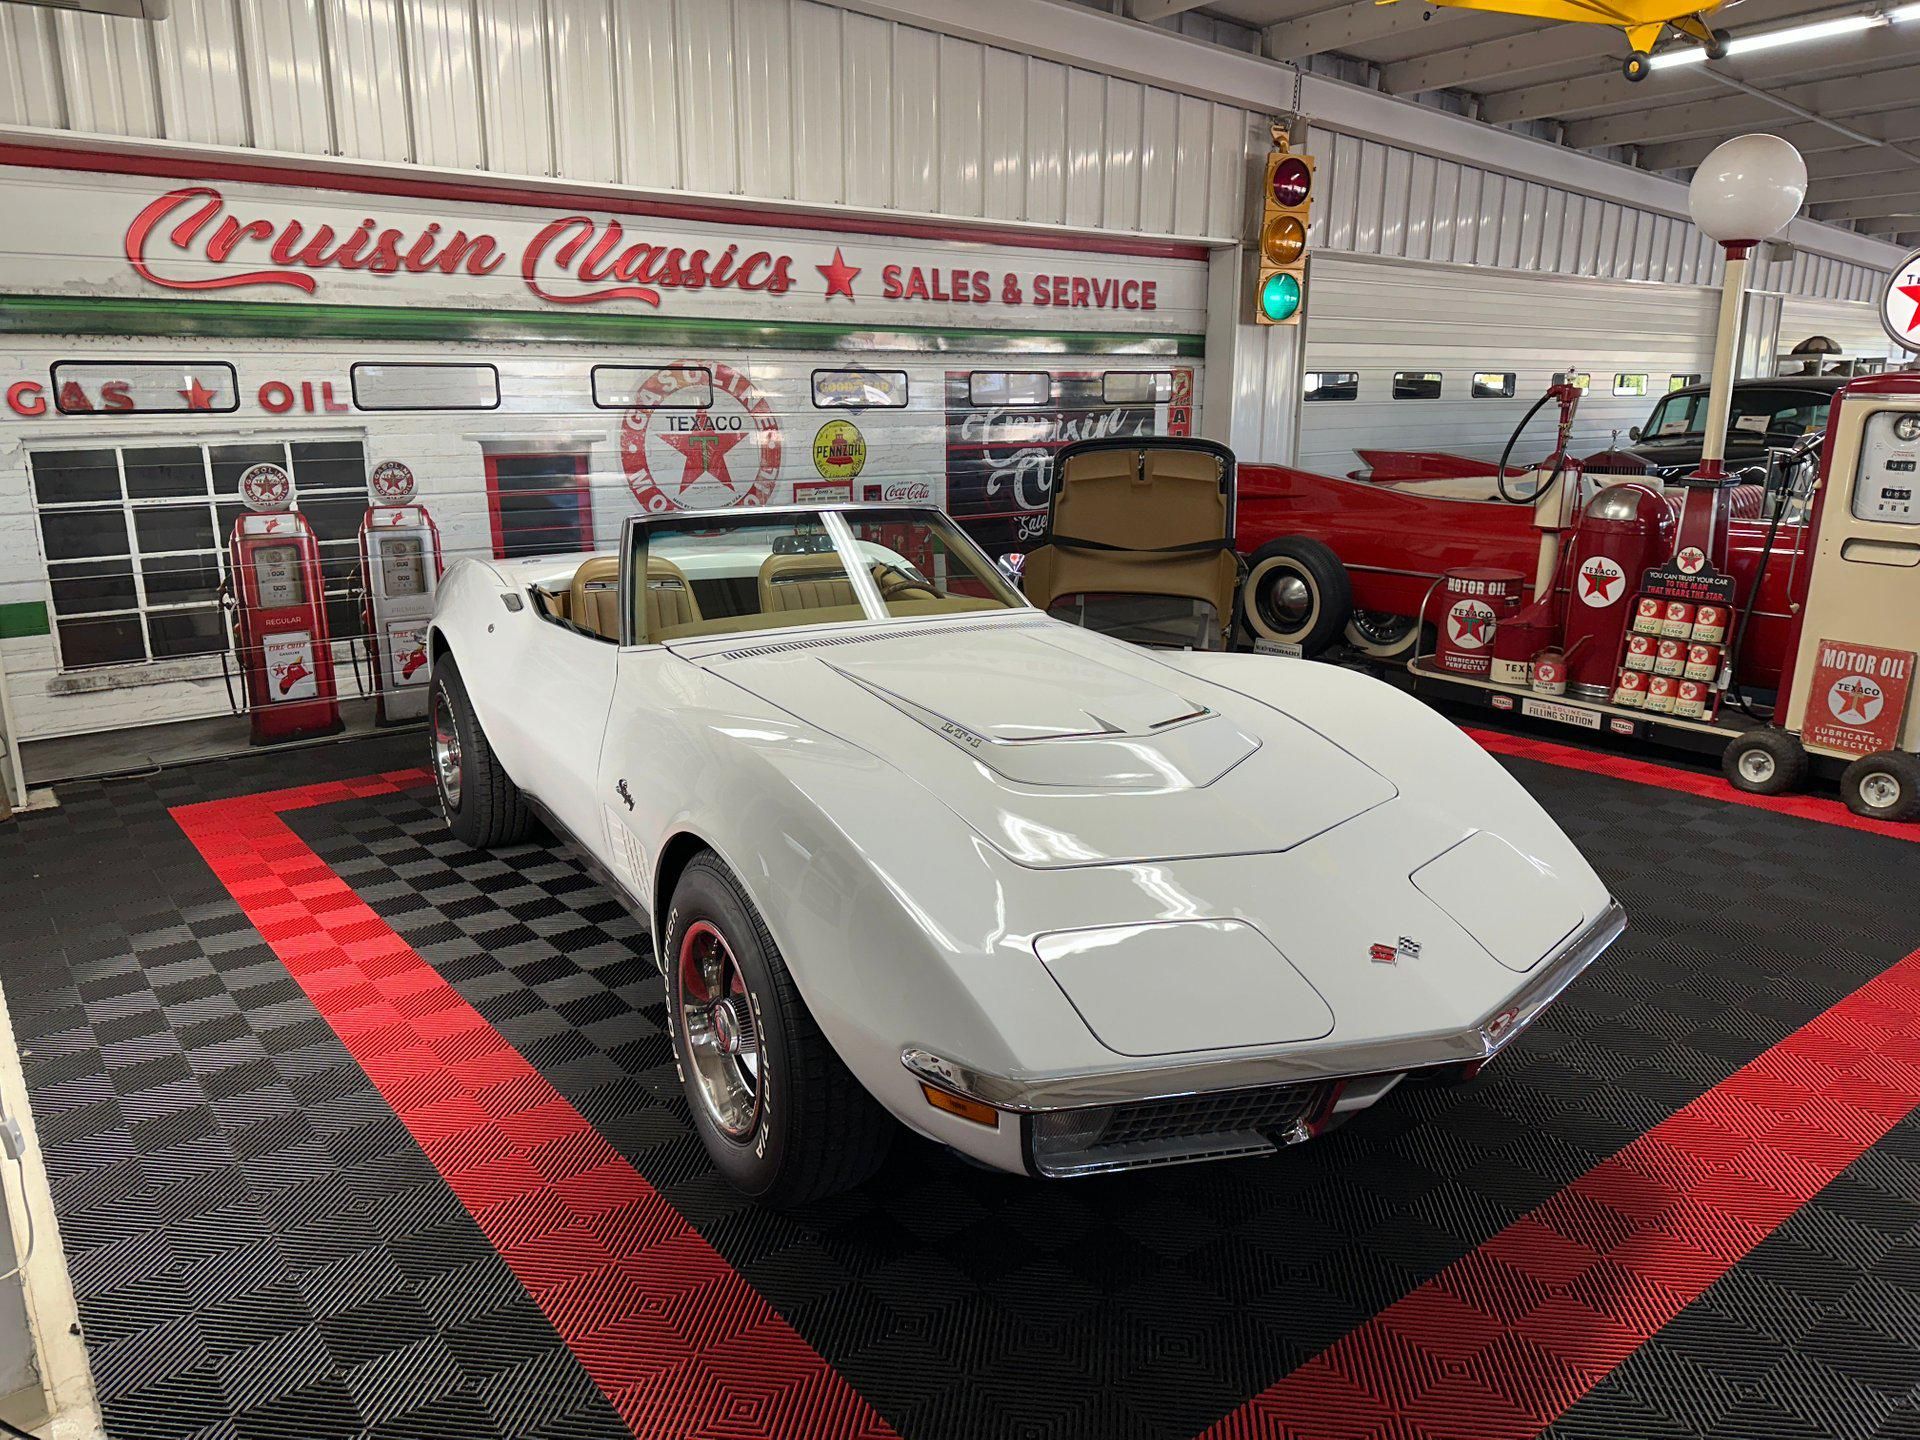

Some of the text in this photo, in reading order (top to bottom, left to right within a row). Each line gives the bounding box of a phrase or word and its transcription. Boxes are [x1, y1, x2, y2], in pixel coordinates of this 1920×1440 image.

[125, 187, 1157, 310] Cruisin Classics SALES & SERVICE
[7, 380, 349, 416] GAS OIL
[625, 361, 780, 432] GASOLINE
[666, 416, 742, 432] TEXACO
[816, 443, 863, 458] PENNZOIL
[1018, 514, 1049, 541] Sale
[1585, 566, 1618, 577] TEXACO
[1650, 571, 1663, 579] YOU
[1678, 574, 1696, 582] TRUST
[1696, 576, 1714, 584] YOUR
[1714, 578, 1728, 586] CAR
[1448, 577, 1506, 596] MOTOR OIL
[1647, 585, 1664, 594] THAT
[1665, 587, 1690, 598] WEARS
[1691, 590, 1705, 599] THE
[1666, 579, 1709, 591] TO THE MAN
[1453, 607, 1493, 619] TEXACO
[265, 616, 301, 626] REGULAR
[1445, 655, 1489, 666] LUBRICATES
[1446, 661, 1488, 671] PERFECTLY
[1505, 663, 1533, 673] TEXA
[1822, 648, 1905, 680] MOTOR OIL
[1837, 682, 1880, 697] TEXACO
[1529, 706, 1594, 727] FILLING STATION
[1542, 704, 1581, 717] GASOLINE
[1612, 721, 1632, 731] TEXACO
[1814, 726, 1883, 745] LUBRICATES
[1815, 735, 1878, 753] PERFECTLY
[750, 992, 770, 1159] Radial T/A
